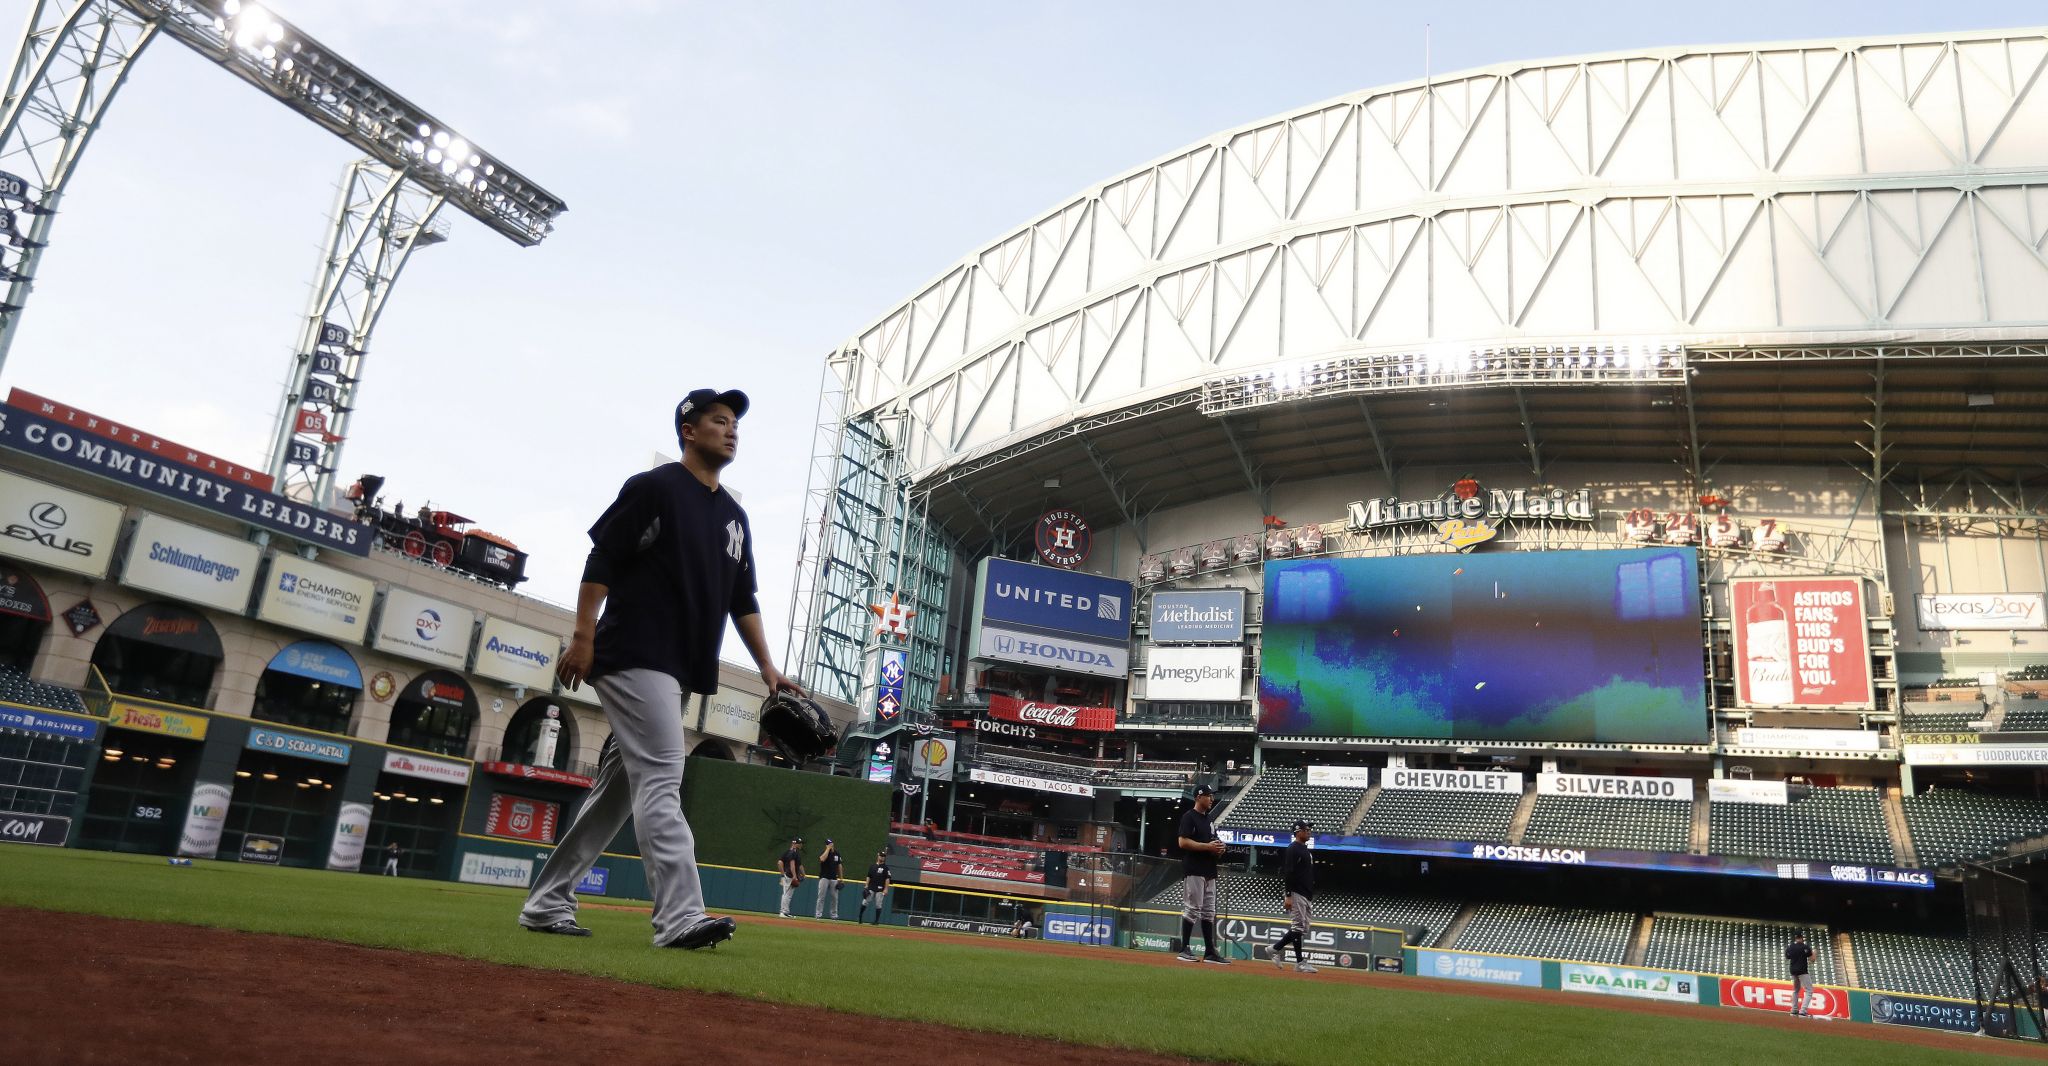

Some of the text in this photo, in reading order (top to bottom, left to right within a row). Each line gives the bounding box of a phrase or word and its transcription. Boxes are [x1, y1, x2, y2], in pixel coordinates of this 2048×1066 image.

[327, 328, 345, 343] 99
[320, 357, 336, 371] 01
[313, 385, 330, 400] 04
[304, 415, 322, 430] 05
[41, 401, 253, 482] MINUTE MAID
[293, 446, 311, 460] 15
[25, 423, 232, 504] COMMUNITY
[242, 494, 359, 546] LEADERS
[1345, 488, 1594, 531] Minute Maid
[1625, 508, 1653, 528] 49
[1044, 511, 1086, 532] HOUSTON
[1438, 519, 1491, 542] Park
[1665, 511, 1696, 531] 24
[1716, 514, 1732, 534] 5
[1760, 517, 1776, 538] 7
[0, 523, 94, 558] EXUS
[1054, 526, 1076, 549] H
[149, 541, 240, 583] Schlumberger
[1043, 548, 1082, 566] ASTROS
[298, 577, 362, 605] CHAMPION
[995, 582, 1092, 612] UNITED
[1793, 590, 1854, 607] ASTROS
[296, 589, 325, 603] ENERGY
[325, 597, 360, 613] SERVICES
[1928, 596, 2036, 620] Texas Bay
[881, 602, 911, 633] H
[1158, 607, 1234, 623] Methodist
[1794, 607, 1839, 624] FANS,
[415, 618, 442, 632] OXY
[1795, 622, 1832, 638] THIS
[409, 641, 435, 653] Petroleum
[435, 648, 464, 660] Corporation
[485, 635, 550, 668] Anadarko
[1017, 640, 1115, 669] HONDA
[1797, 638, 1845, 654] BUD'S
[1798, 653, 1830, 670] FOR
[1150, 664, 1236, 683] AmegyBank
[1799, 669, 1837, 686] YOU.
[124, 707, 162, 729] Fiesta
[1019, 702, 1081, 727] Coca-Cola
[36, 718, 86, 733] AIRLINES
[973, 718, 1037, 739] TORCHYS
[255, 732, 265, 746] C
[274, 735, 285, 748] D
[287, 739, 316, 754] SCRAP
[318, 745, 344, 759] METAL
[1956, 733, 1980, 743] PM
[992, 773, 1074, 793] TORCHYS TACOS
[1394, 771, 1508, 791] CHEVROLET
[1555, 777, 1675, 797] SILVERADO
[135, 806, 163, 819] 362
[512, 814, 529, 827] 66
[1253, 834, 1275, 844] ALCS
[242, 851, 278, 862] CHEVROLET
[536, 852, 548, 860] 404
[1472, 845, 1587, 864] #POSTSEASON
[480, 862, 529, 880] Insperity
[961, 864, 1009, 878] Budweiser
[1830, 865, 1867, 876] CAMPING
[1831, 871, 1928, 884] WORLD ALCS
[920, 918, 970, 932] NITTOTIRE.COM
[1048, 919, 1111, 939] GEICO
[1250, 925, 1335, 946] LEUS
[1344, 930, 1365, 940] 373
[1455, 957, 1484, 969] AT&T
[1455, 966, 1523, 982] SPORTSNET
[1568, 973, 1648, 990] EVA AIR
[1884, 1001, 2007, 1024] HOUSTON'S FST
[1939, 1017, 1976, 1028] CHURC
